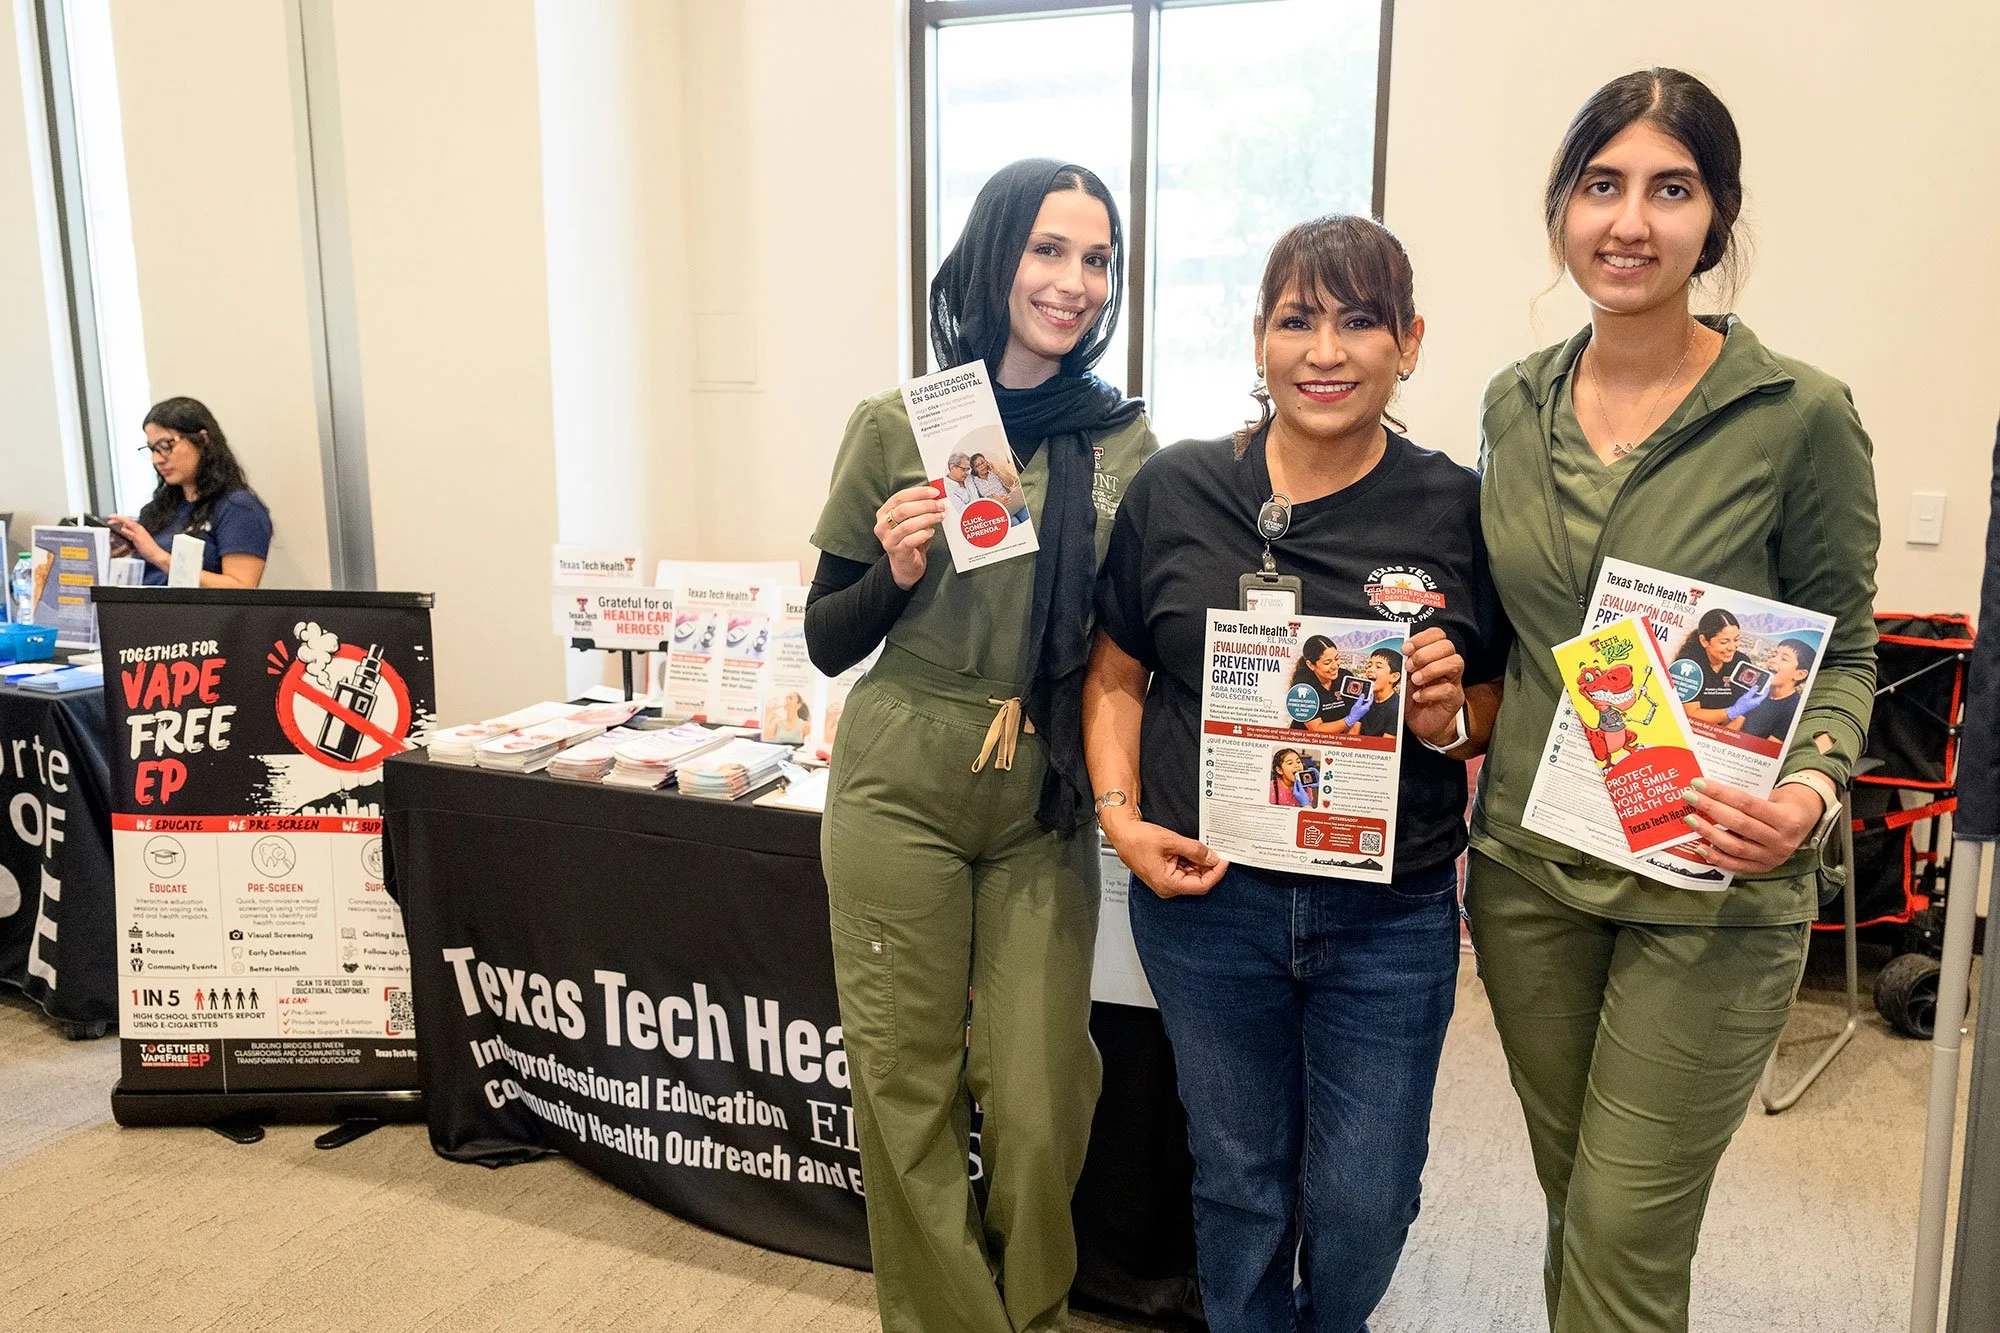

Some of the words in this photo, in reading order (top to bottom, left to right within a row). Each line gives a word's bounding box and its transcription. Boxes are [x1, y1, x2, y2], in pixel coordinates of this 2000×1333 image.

[912, 396, 923, 405] EN
[924, 388, 950, 401] SALUD
[952, 378, 983, 393] DIGITAL
[560, 560, 580, 570] Texas
[582, 560, 599, 570] Tech
[600, 561, 625, 571] Health
[1367, 566, 1404, 582] TEXAS
[1407, 566, 1437, 590] TECH
[688, 588, 707, 599] Texas
[709, 589, 724, 600] Tech
[727, 590, 749, 601] Health
[1385, 588, 1440, 601] BORDERLAND
[1607, 572, 1632, 588] Texas
[1634, 579, 1655, 595] Tech
[1656, 585, 1688, 604] Health
[598, 596, 641, 608] Grateful
[644, 597, 659, 609] for
[786, 603, 806, 614] Texa
[1661, 600, 1671, 608] EL
[1673, 602, 1695, 615] PASO
[603, 610, 644, 622] HEALTH
[647, 611, 672, 622] CAR
[1374, 605, 1404, 623] HEALTH
[1418, 607, 1435, 621] PASO
[1660, 610, 1684, 628] ORAL
[616, 623, 664, 635] HEROES!
[1214, 621, 1237, 633] Texas
[1239, 623, 1258, 635] Tech
[1260, 625, 1288, 637] Health
[1213, 641, 1267, 656] ¡EVALUACIÓN
[1269, 645, 1290, 658] ORAL
[1278, 637, 1297, 645] PASO
[119, 643, 189, 664] TOGETHER
[192, 640, 219, 657] FOR
[1213, 654, 1280, 673] PREVENTIVA
[121, 658, 227, 710] VAPE
[1212, 669, 1259, 687] GRATIS!
[1211, 692, 1263, 702] ADOLESCENTES
[126, 705, 237, 760] FREE
[0, 735, 70, 793] rte
[135, 758, 187, 805] EP
[1606, 765, 1653, 789] PROTECT
[1610, 782, 1641, 799] YOUR
[1642, 768, 1679, 788] SMILE:
[1614, 792, 1646, 809] YOUR
[1647, 781, 1677, 798] ORAL
[1618, 798, 1663, 820] HEALTH
[1664, 785, 1696, 803] GUID
[9, 792, 66, 859] OF
[136, 819, 152, 830] WE
[155, 819, 203, 831] EDUCATE
[228, 820, 246, 831] WE
[249, 819, 319, 831] PRE-SCREEN
[341, 820, 360, 832] WE
[362, 821, 381, 833] SUP
[1628, 821, 1651, 835] Texas
[1650, 813, 1670, 827] Tech
[1668, 804, 1697, 820] Health
[150, 883, 188, 893] EDUCATE
[248, 882, 303, 893] PRE-SCREEN
[170, 906, 191, 914] vaping
[248, 949, 268, 957] Early
[147, 963, 190, 972] Community
[132, 989, 138, 1006] 1
[143, 989, 162, 1006] IN
[168, 990, 180, 1007] 5
[442, 947, 586, 1040] Texas
[593, 969, 734, 1063] Tech
[744, 995, 851, 1090] Hea
[140, 1044, 204, 1053] TOGETHER
[188, 1053, 211, 1067] EP
[469, 1034, 649, 1109] Interprofessional
[656, 1078, 788, 1131] Education
[587, 1113, 659, 1163] Health
[665, 1131, 791, 1181] Outreach
[798, 1155, 848, 1190] and
